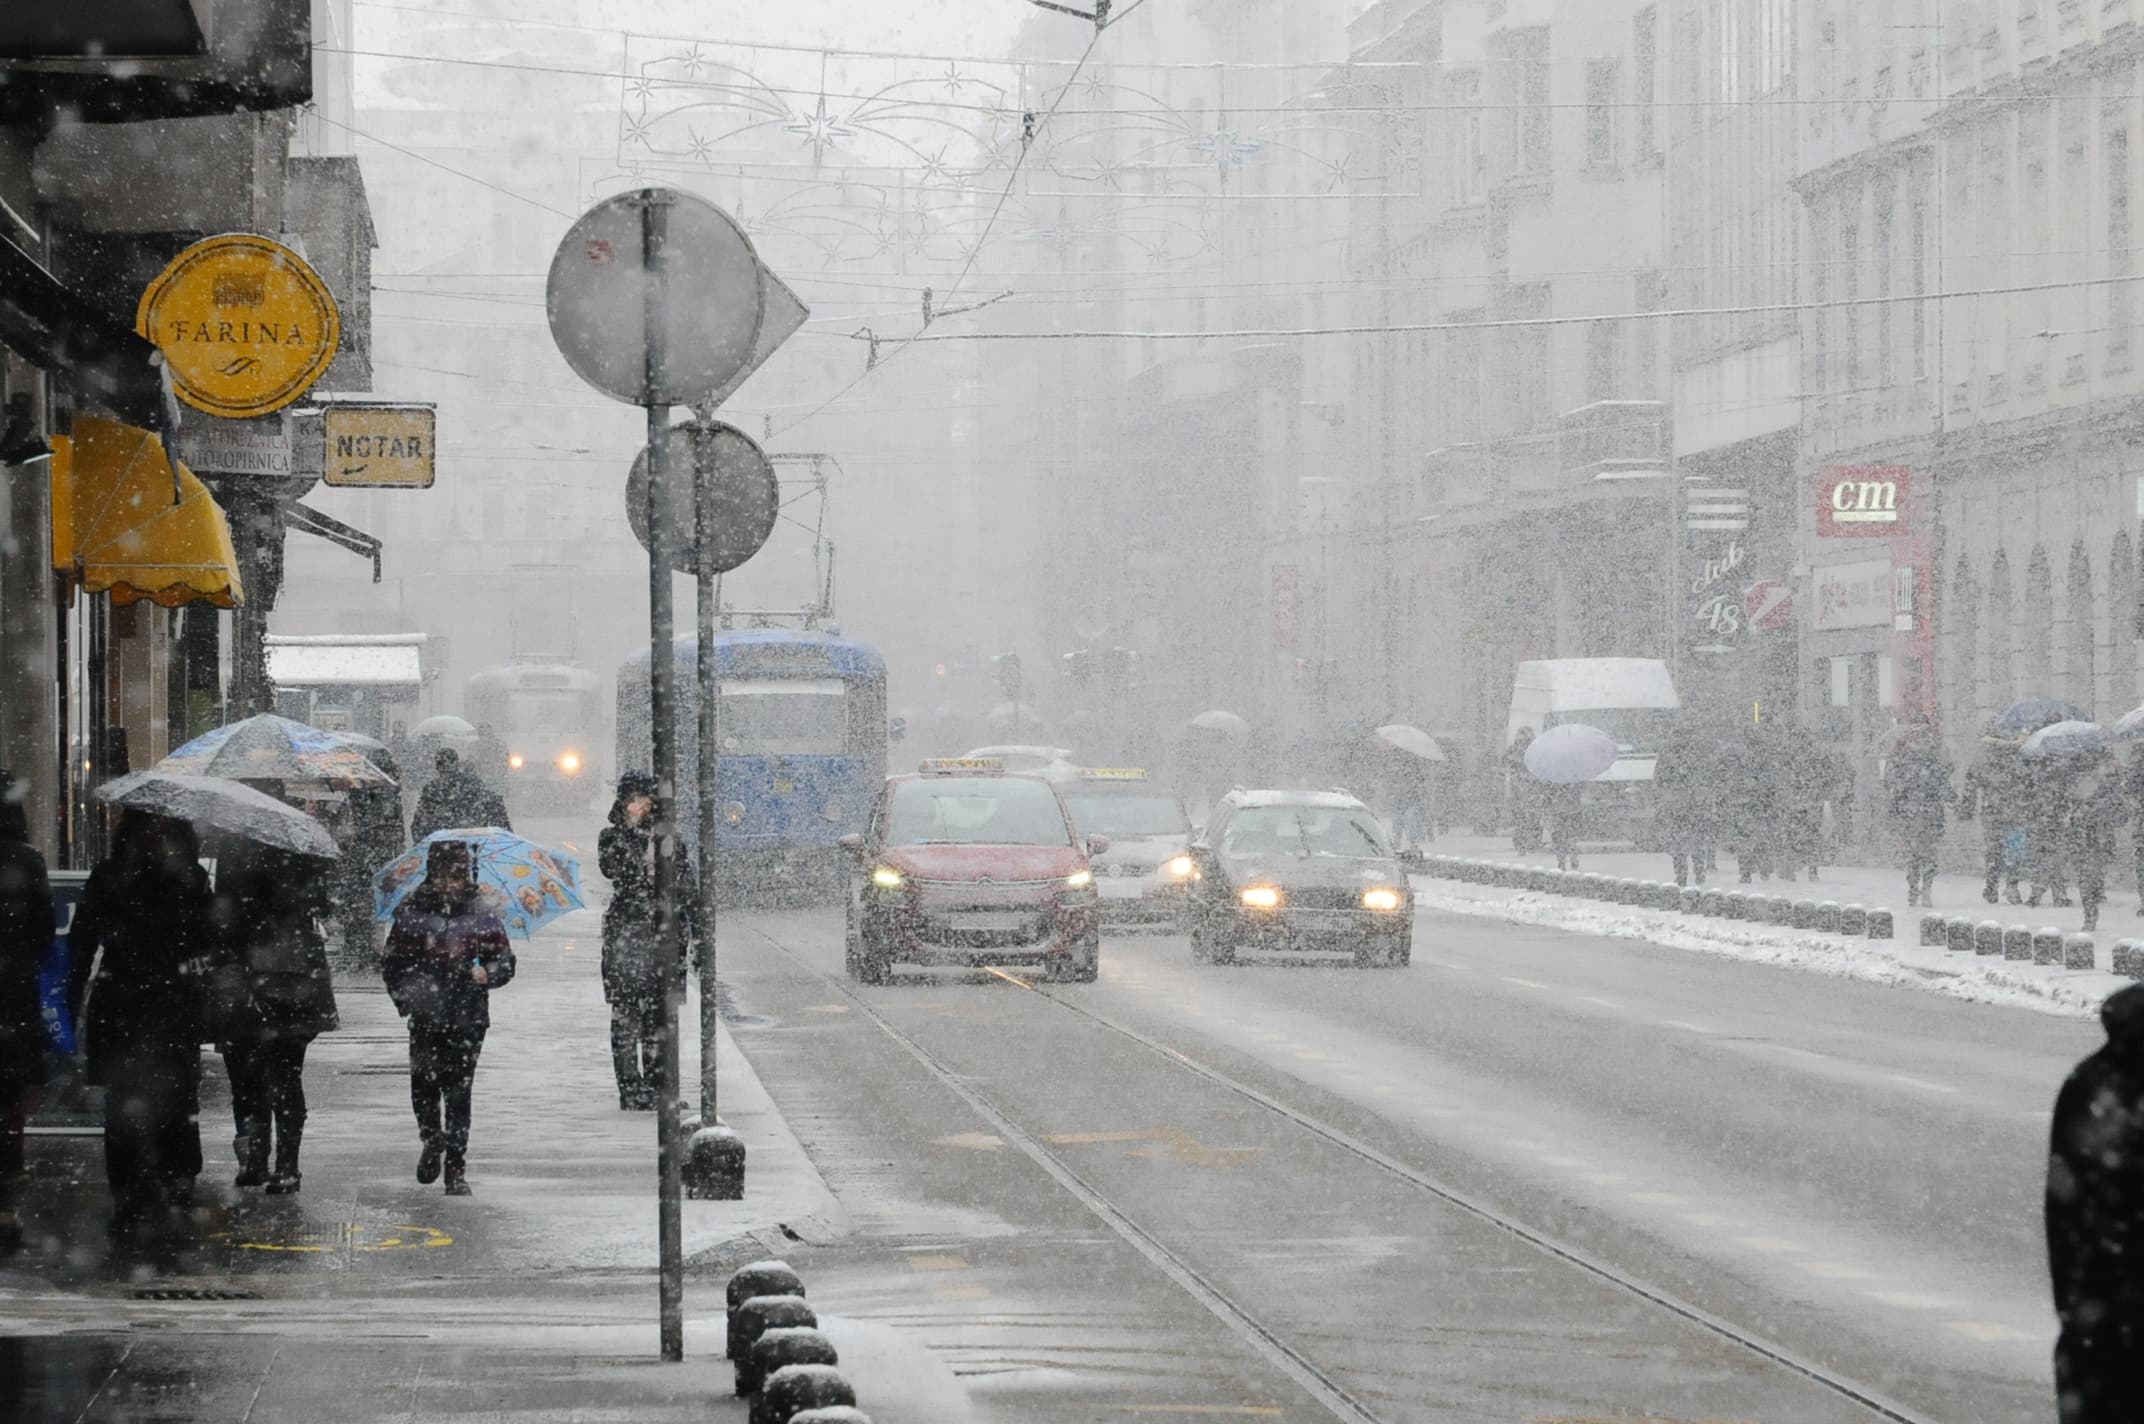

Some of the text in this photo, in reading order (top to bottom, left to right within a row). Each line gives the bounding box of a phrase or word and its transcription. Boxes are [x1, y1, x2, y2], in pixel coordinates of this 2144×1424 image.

[169, 320, 305, 345] FARINA
[335, 434, 423, 459] NOTAR
[1832, 481, 1897, 511] cm
[1695, 595, 1741, 635] 48
